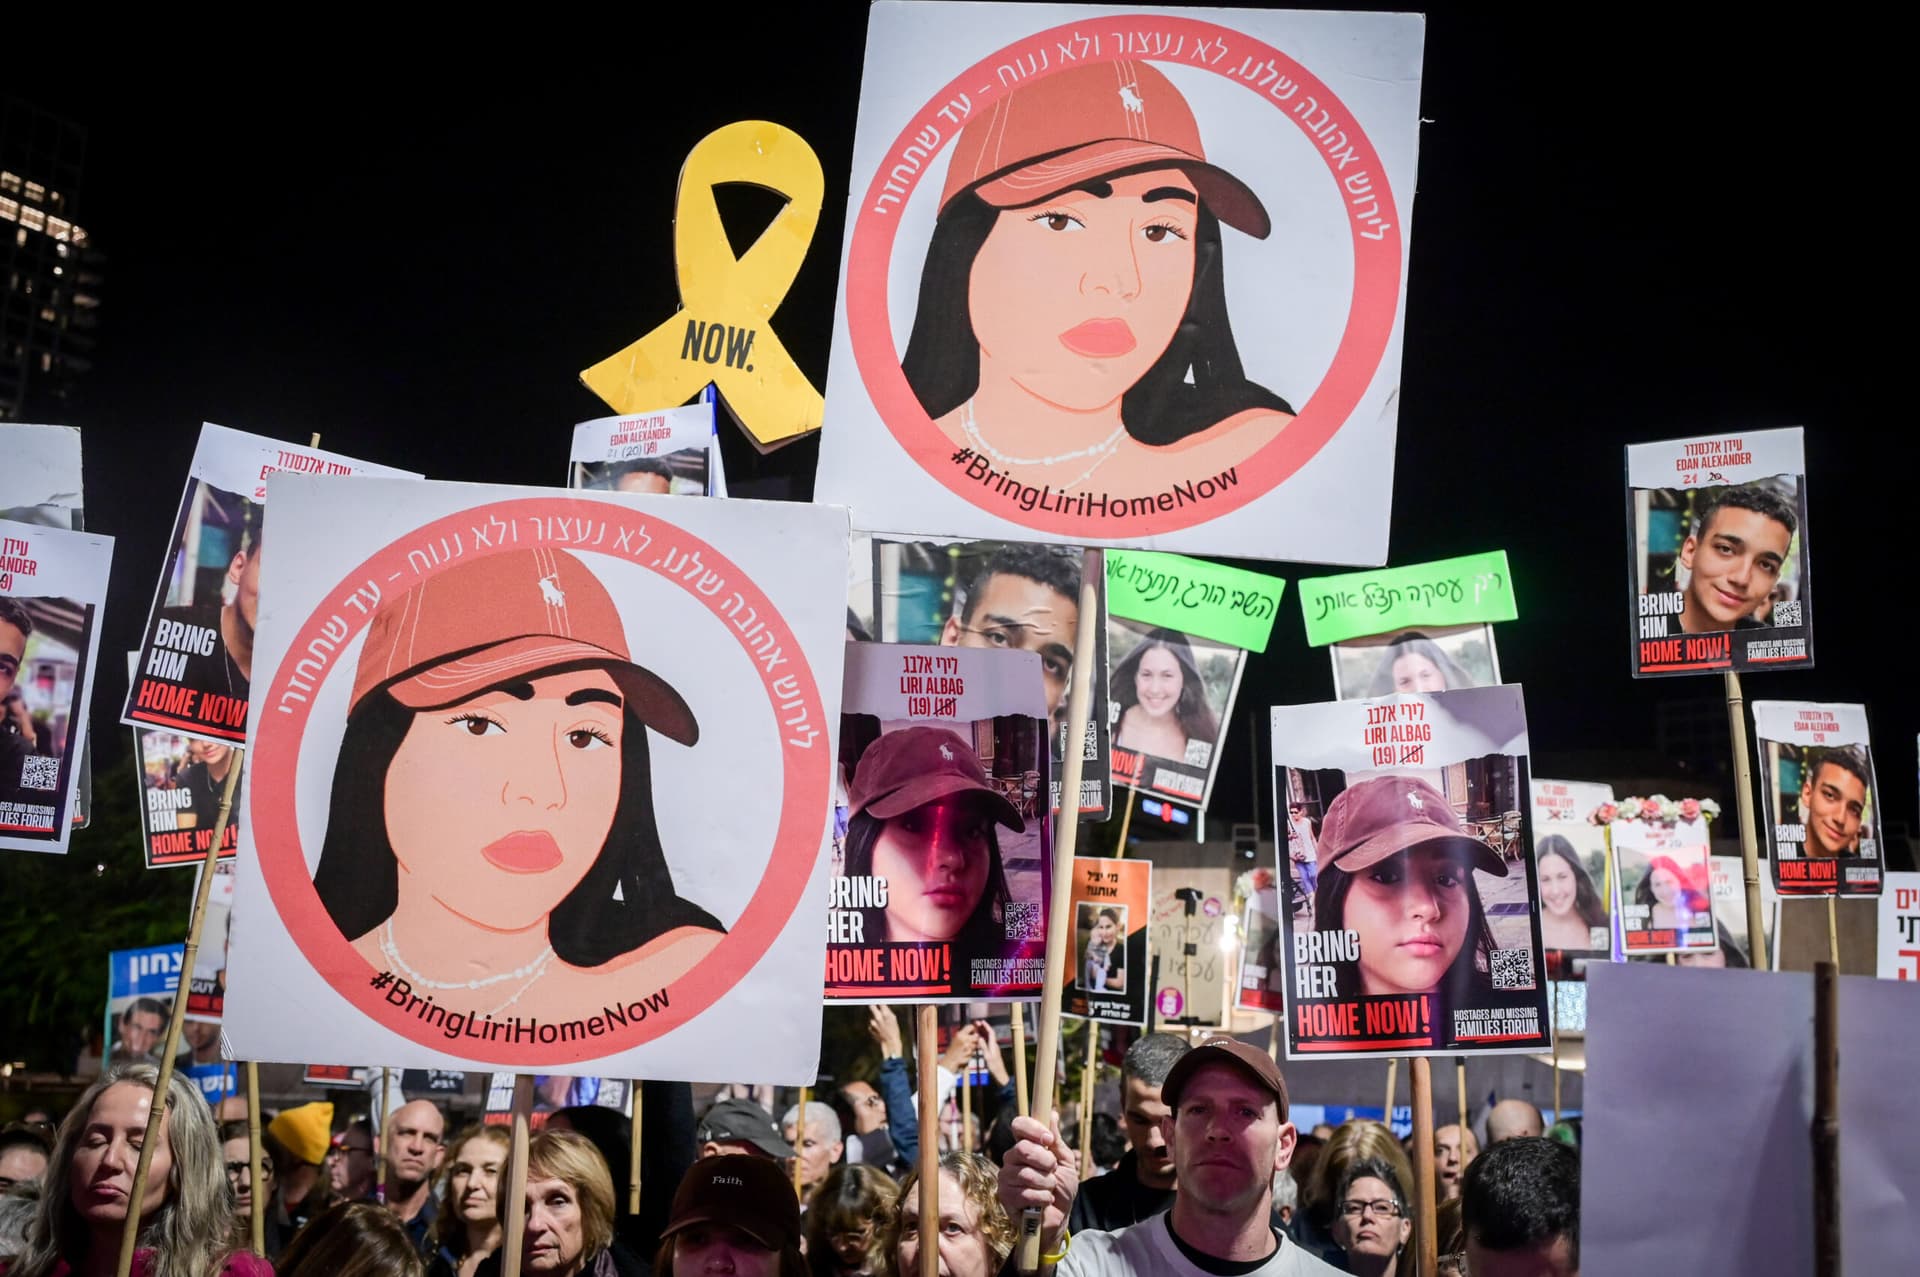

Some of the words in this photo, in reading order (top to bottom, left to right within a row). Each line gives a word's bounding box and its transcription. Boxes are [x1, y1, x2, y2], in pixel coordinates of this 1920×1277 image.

[1057, 31, 1100, 64] ולא
[1111, 31, 1184, 57] נעצור
[1191, 36, 1228, 65] לא
[997, 49, 1049, 87] ננוח
[1227, 56, 1298, 100] שלנו,
[937, 92, 973, 124] עד
[1294, 96, 1360, 171] אהובה
[873, 124, 941, 214] שתחזרי
[1343, 149, 1391, 241] לירוש
[680, 319, 756, 372] NOW.
[610, 434, 629, 446] EDAN
[630, 428, 672, 443] ALEXANDER
[1683, 440, 1721, 456] אלכסנדר
[1724, 438, 1743, 453] עידן
[1676, 458, 1699, 471] EDAN
[1701, 452, 1752, 469] ALEXANDER
[951, 447, 1239, 518] #BringLiriHomeNow
[471, 515, 518, 550] ולא
[529, 516, 606, 544] נעצור
[613, 524, 652, 556] לא
[3, 538, 28, 556] עידן
[407, 533, 463, 574] ננוח
[651, 547, 725, 596] שלנו,
[344, 580, 382, 614] עד
[1229, 591, 1274, 620] השבי
[1315, 592, 1358, 621] אותי
[1363, 582, 1402, 615] תציל
[1406, 578, 1463, 608] עסקה
[1639, 591, 1684, 617] BRING
[154, 618, 218, 656] BRING
[720, 592, 788, 673] אהובה
[1639, 616, 1668, 639] HIM
[1640, 640, 1682, 664] HOME
[1686, 633, 1732, 661] NOW!
[1748, 647, 1779, 660] FAMILIES
[1780, 645, 1806, 657] FORUM
[146, 648, 188, 681] HIM
[277, 615, 348, 714] שתחזרי
[903, 655, 933, 674] אלבג
[936, 656, 958, 675] לירי
[137, 679, 198, 717] HOME
[900, 677, 923, 695] LIRI
[926, 677, 964, 696] ALBAG
[772, 673, 820, 749] לירוש
[908, 697, 931, 717] (19)
[1367, 704, 1397, 725] אלבג
[1400, 702, 1425, 721] לירי
[1364, 726, 1387, 746] LIRI
[1390, 724, 1432, 744] ALBAG
[1372, 747, 1397, 767] (19)
[13, 803, 27, 813] AND
[27, 804, 56, 816] MISSING
[146, 787, 192, 811] BRING
[20, 813, 54, 829] FORUM
[149, 810, 178, 833] HIM
[1776, 824, 1806, 842] BRING
[151, 831, 193, 855] HOME
[1777, 842, 1797, 860] HIM
[1779, 862, 1807, 880] HOME
[1809, 860, 1837, 880] NOW!
[826, 911, 864, 943] HER
[1293, 929, 1360, 965] BRING
[825, 948, 885, 983] HOME
[890, 944, 950, 982] NOW!
[970, 958, 1002, 969] HOSTAGES
[1003, 958, 1016, 969] AND
[1016, 958, 1045, 969] MISSING
[971, 969, 1011, 985] FAMILIES
[1296, 965, 1338, 999] HER
[370, 970, 670, 1044] #BringLiriHomeNow
[1297, 1003, 1361, 1037] HOME
[1365, 995, 1431, 1036] NOW!
[1454, 1009, 1490, 1021] HOSTAGES
[1491, 1008, 1505, 1019] AND
[1506, 1007, 1538, 1019] MISSING
[1455, 1020, 1500, 1037] FAMILIES
[1502, 1018, 1539, 1035] FORUM
[712, 1175, 744, 1186] Faith
